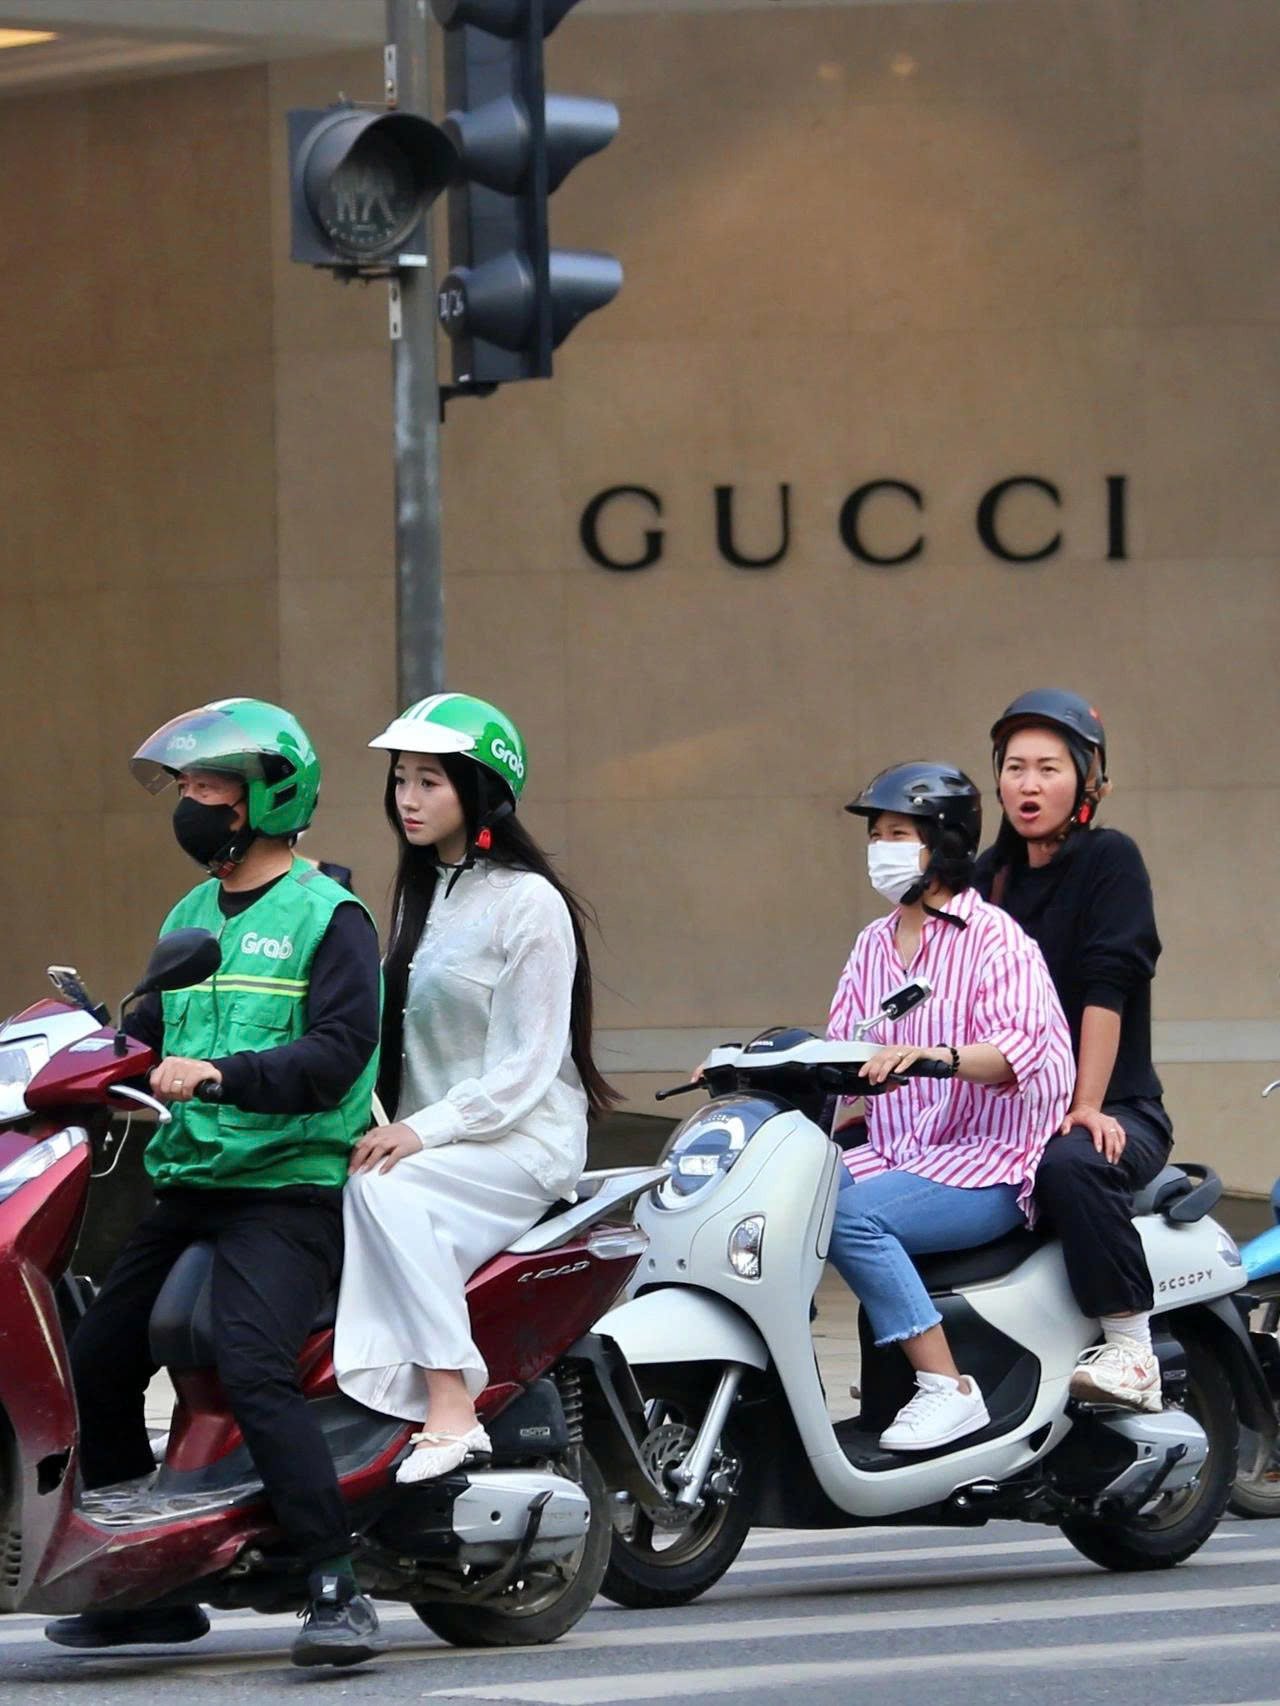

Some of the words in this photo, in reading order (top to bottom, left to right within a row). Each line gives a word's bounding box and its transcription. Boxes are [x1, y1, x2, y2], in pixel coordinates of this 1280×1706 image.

[578, 474, 1130, 575] GUCCI
[490, 737, 525, 779] Grab
[240, 931, 293, 960] Grab
[1158, 1268, 1214, 1293] SCOOPY
